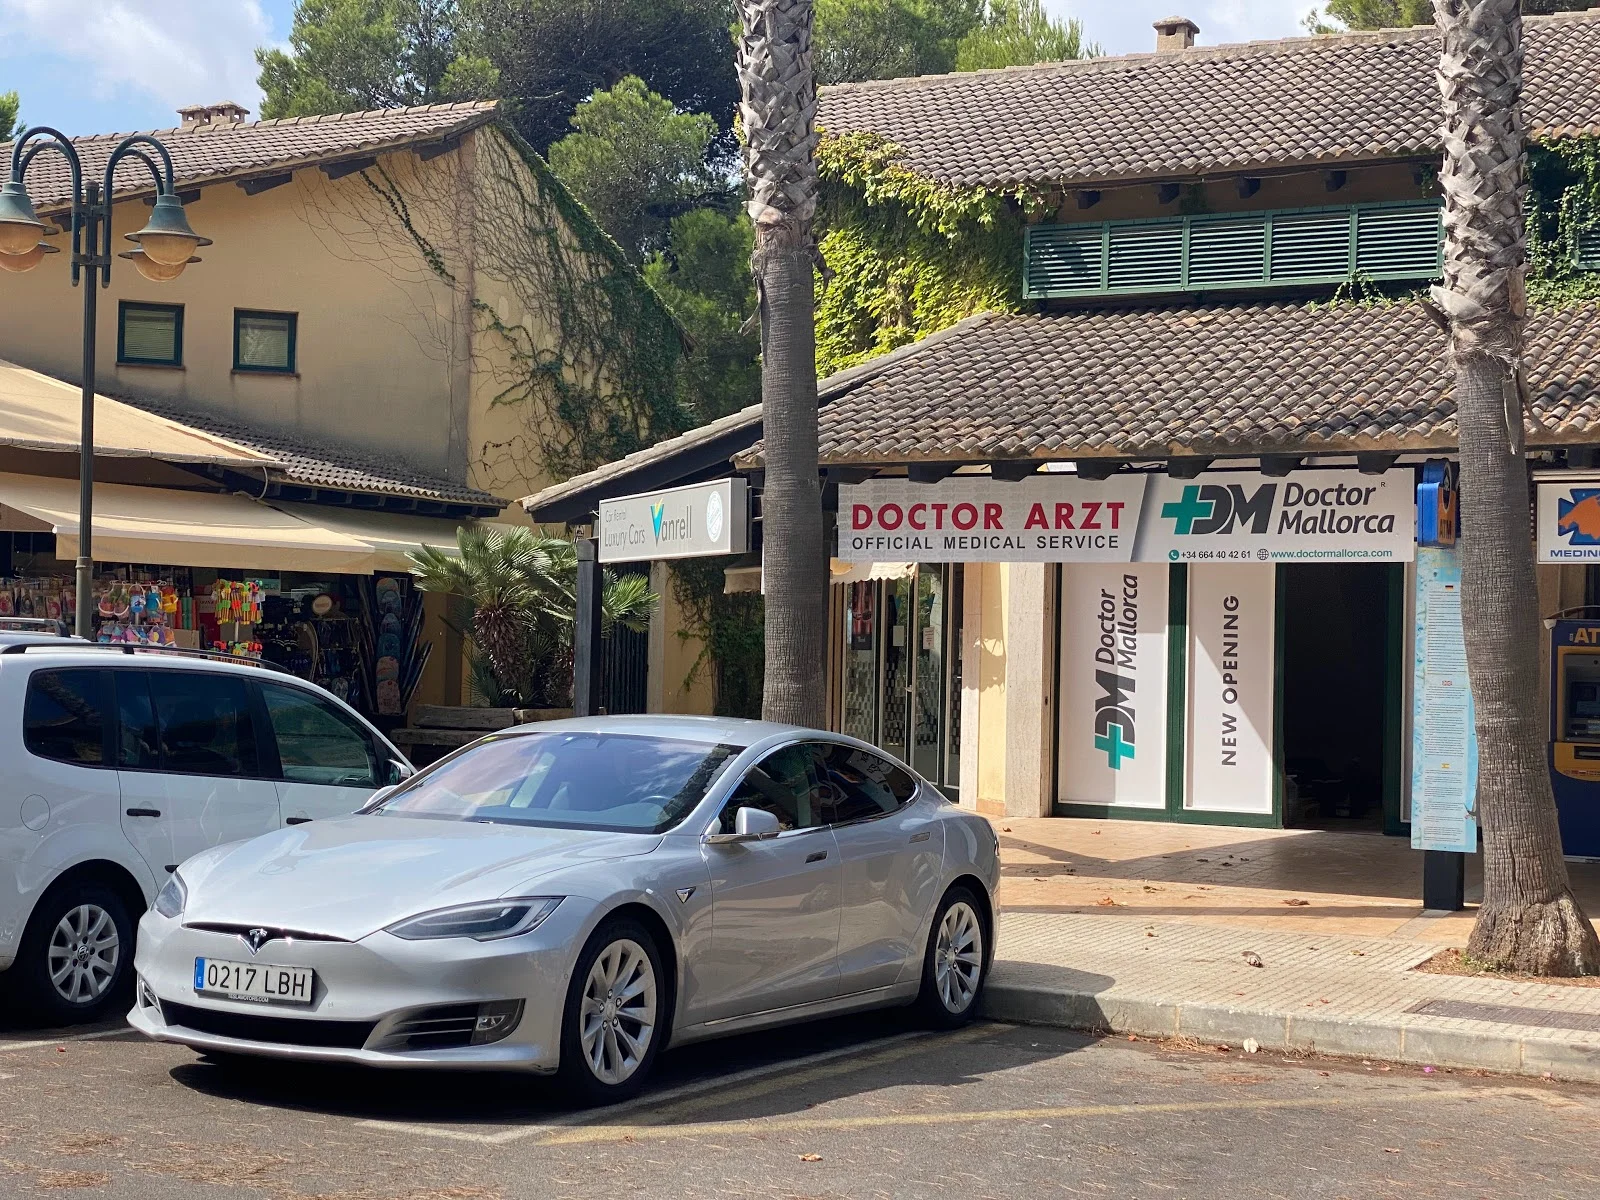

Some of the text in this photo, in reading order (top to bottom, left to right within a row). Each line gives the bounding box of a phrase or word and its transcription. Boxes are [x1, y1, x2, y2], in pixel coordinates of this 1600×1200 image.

[1282, 482, 1377, 508] Doctor
[852, 502, 1125, 531] DOCTOR ARZT
[1277, 509, 1396, 535] Mallorca
[604, 524, 646, 550] Luxury Cars
[852, 535, 1120, 550] OFFICIAL MEDICAL SERVICE
[1181, 551, 1251, 559] +34 664 40 42 61
[1270, 549, 1393, 558] www.doctormallorca.com
[1550, 549, 1600, 558] MEDIN
[1095, 588, 1116, 665] Doctor
[1117, 574, 1138, 670] Mallorca
[1222, 595, 1240, 766] NEW OPENING
[207, 964, 306, 997] 0217 LBH
